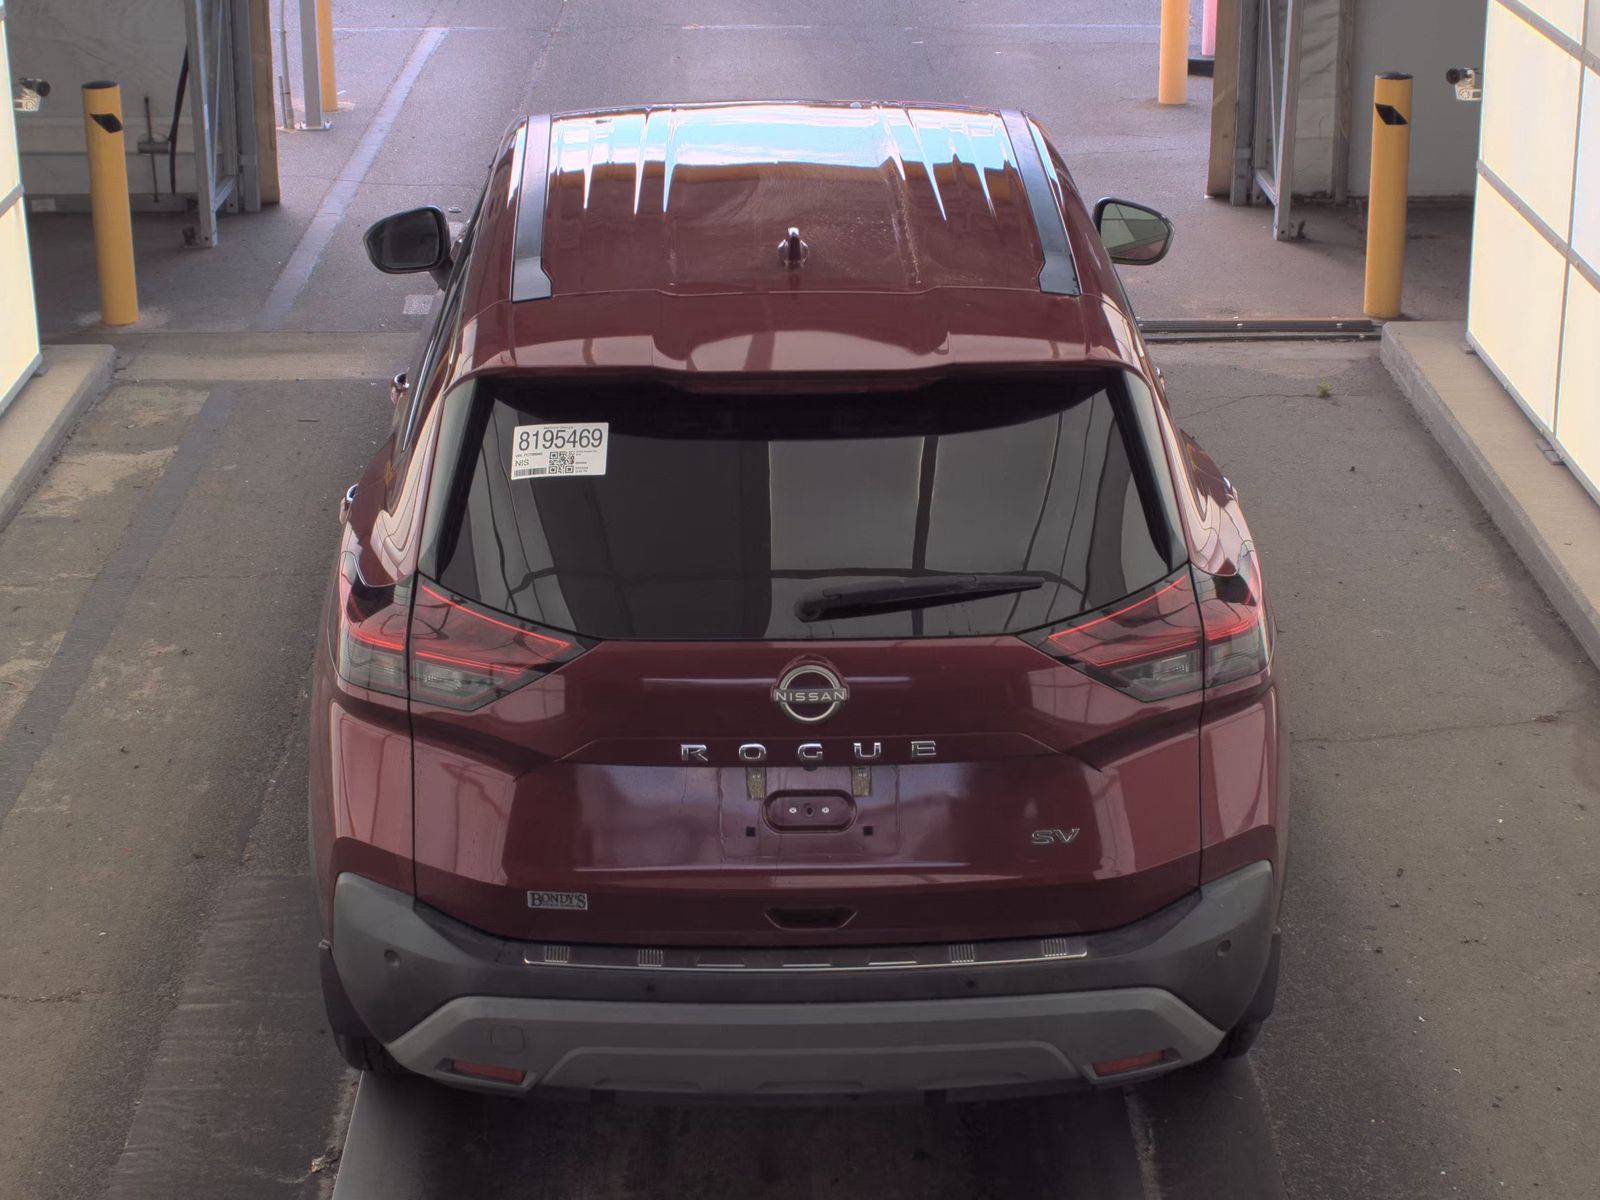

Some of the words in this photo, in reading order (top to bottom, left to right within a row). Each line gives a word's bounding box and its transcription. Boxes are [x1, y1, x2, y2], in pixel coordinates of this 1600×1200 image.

[518, 428, 603, 451] 8195469
[515, 459, 529, 467] NIS
[775, 690, 846, 702] NISSAN
[680, 740, 937, 762] ROGUE
[1031, 828, 1080, 845] SV
[530, 892, 586, 909] BONDY'S
